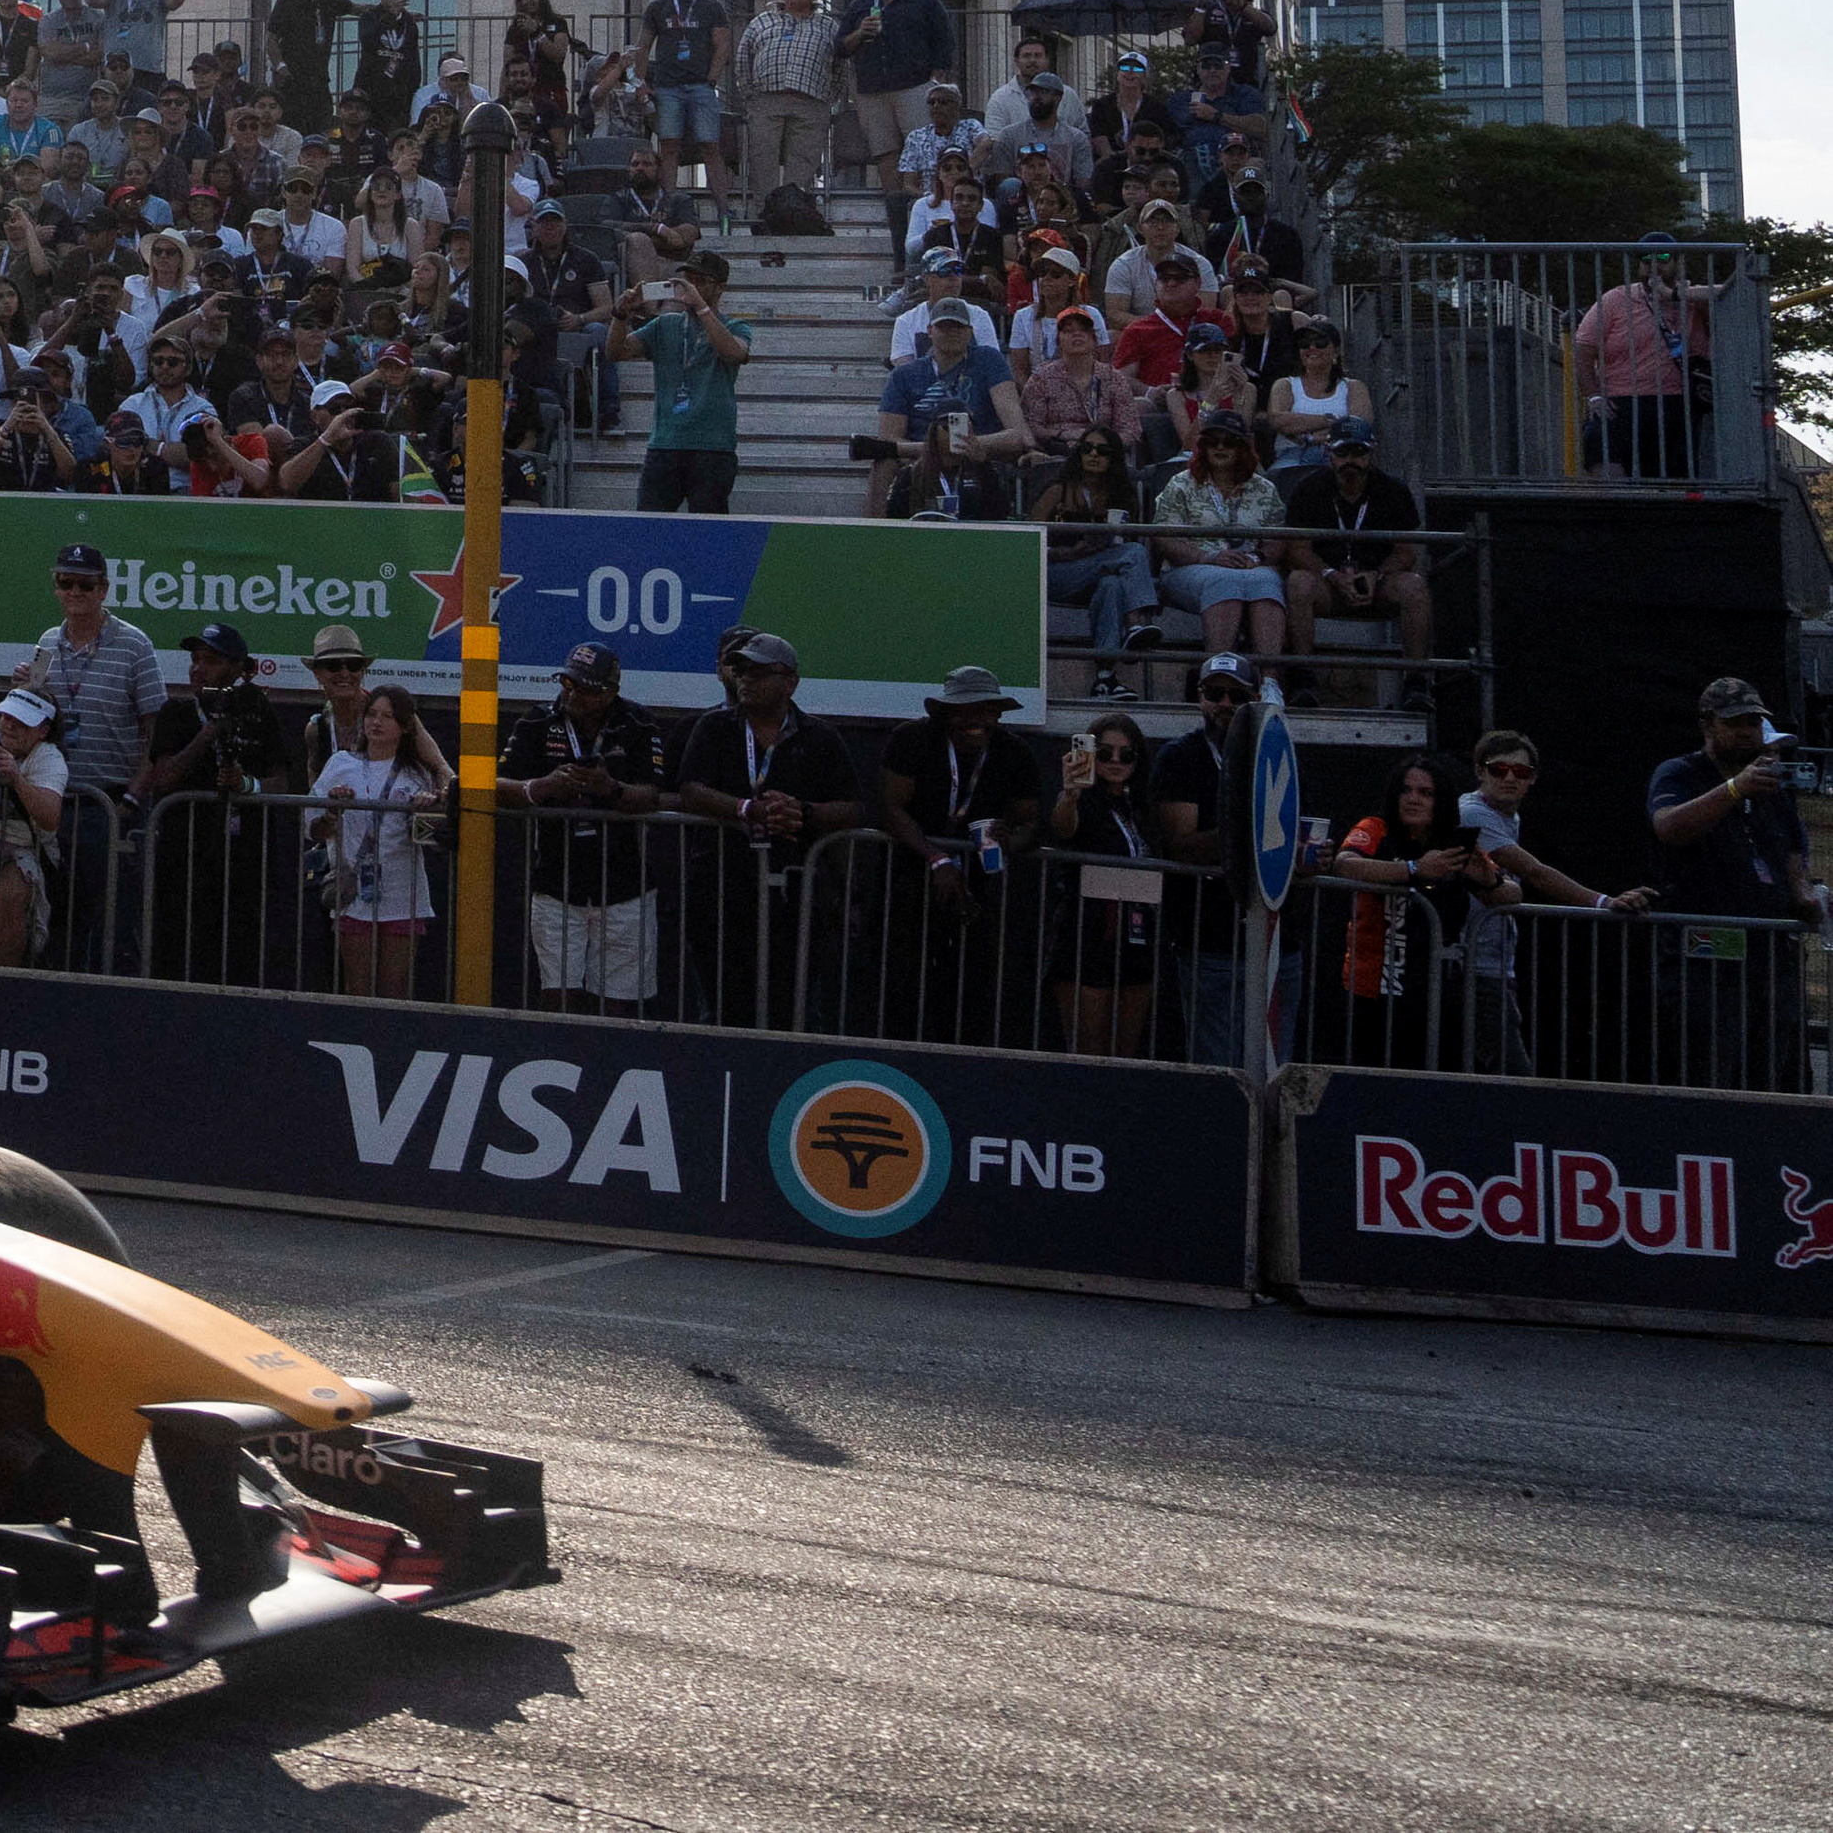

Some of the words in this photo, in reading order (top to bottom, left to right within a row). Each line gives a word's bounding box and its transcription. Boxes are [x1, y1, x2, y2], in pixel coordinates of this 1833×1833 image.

[103, 558, 391, 618] Heineken
[586, 566, 683, 635] 0.0
[397, 670, 427, 678] UNDER
[430, 671, 447, 679] THE
[498, 675, 527, 683] ENJOY
[308, 1040, 682, 1193] VISA
[969, 1136, 1106, 1192] FNB
[1355, 1134, 1546, 1244] Red
[1552, 1149, 1737, 1258] Bull
[269, 1430, 382, 1486] Claro
